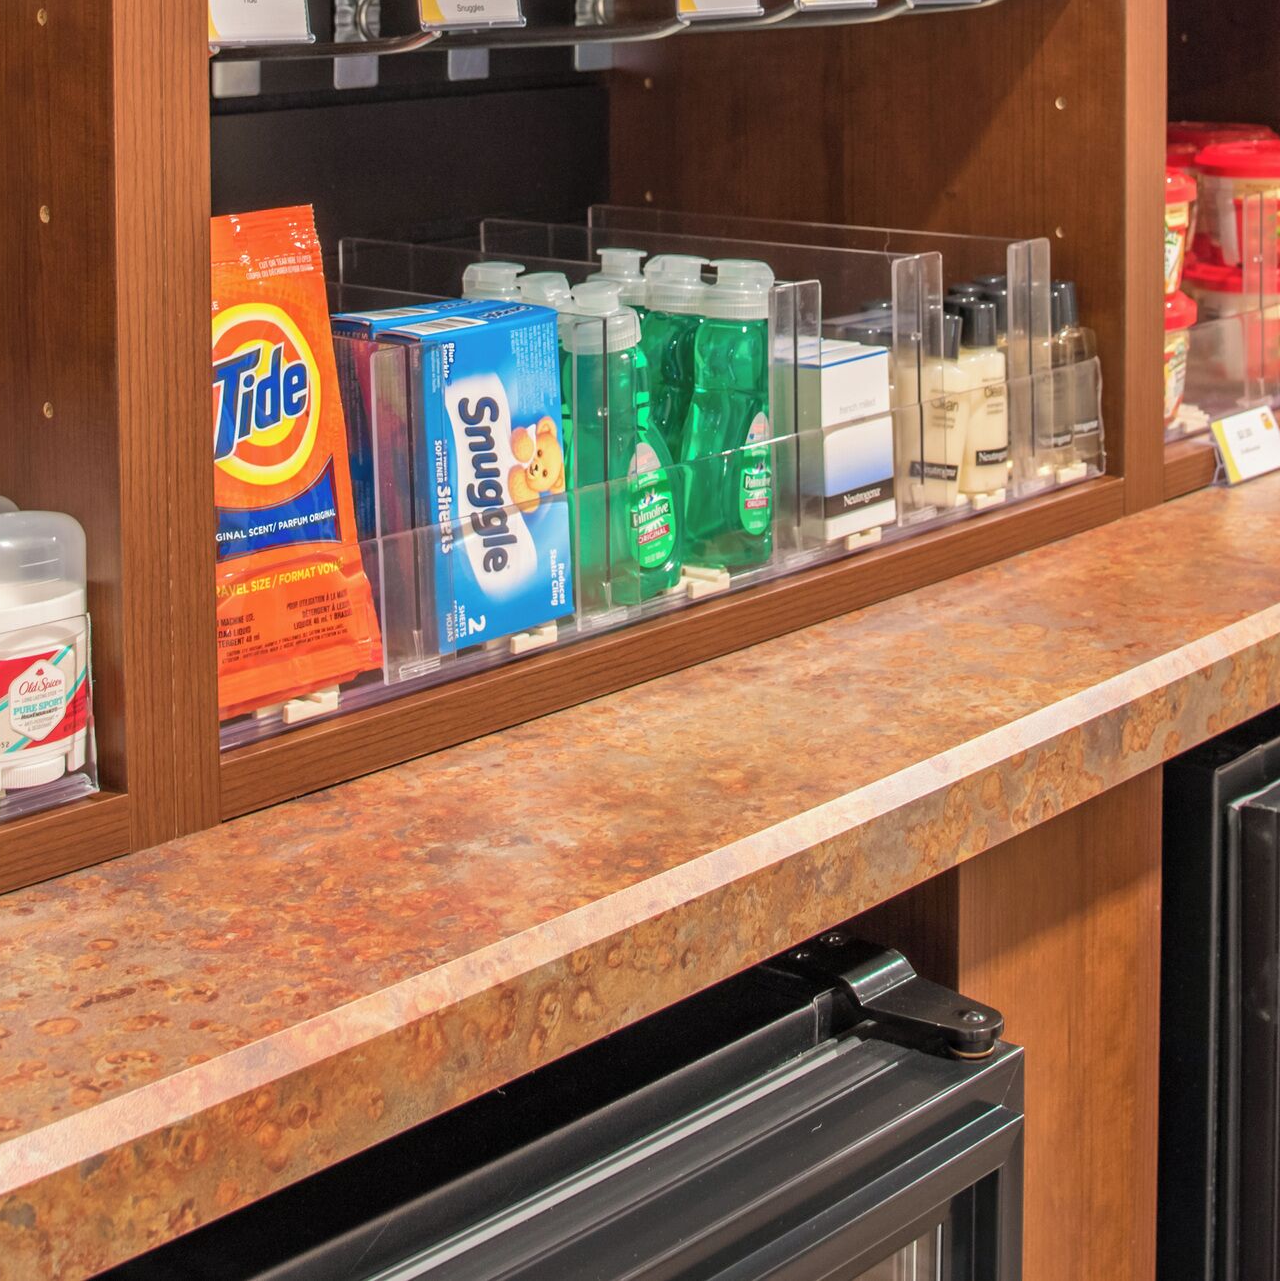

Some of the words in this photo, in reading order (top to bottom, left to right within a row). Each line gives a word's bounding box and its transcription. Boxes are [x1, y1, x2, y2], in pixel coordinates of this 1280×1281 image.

[456, 3, 485, 14] Snuggles
[447, 342, 455, 364] Blue
[213, 342, 309, 460] Tide
[434, 440, 445, 484] SOFTENER
[457, 396, 518, 574] Snuggle
[215, 529, 247, 542] GINAL
[248, 522, 277, 538] SCENT/
[278, 518, 308, 531] PARFUM
[309, 508, 336, 523] ORIGINAL
[437, 485, 453, 554] Sheets
[638, 527, 667, 544] ORIGINAL
[549, 549, 558, 583] Static
[251, 577, 271, 593] SIZE
[279, 569, 316, 586] FORMAT
[557, 563, 566, 605] Reduces
[550, 584, 559, 607] Cling
[458, 605, 466, 637] SHEETS
[468, 615, 486, 635] 2
[19, 680, 39, 696] Old
[38, 677, 60, 694] Spice
[13, 703, 38, 716] PURE
[38, 697, 63, 710] SPORT
